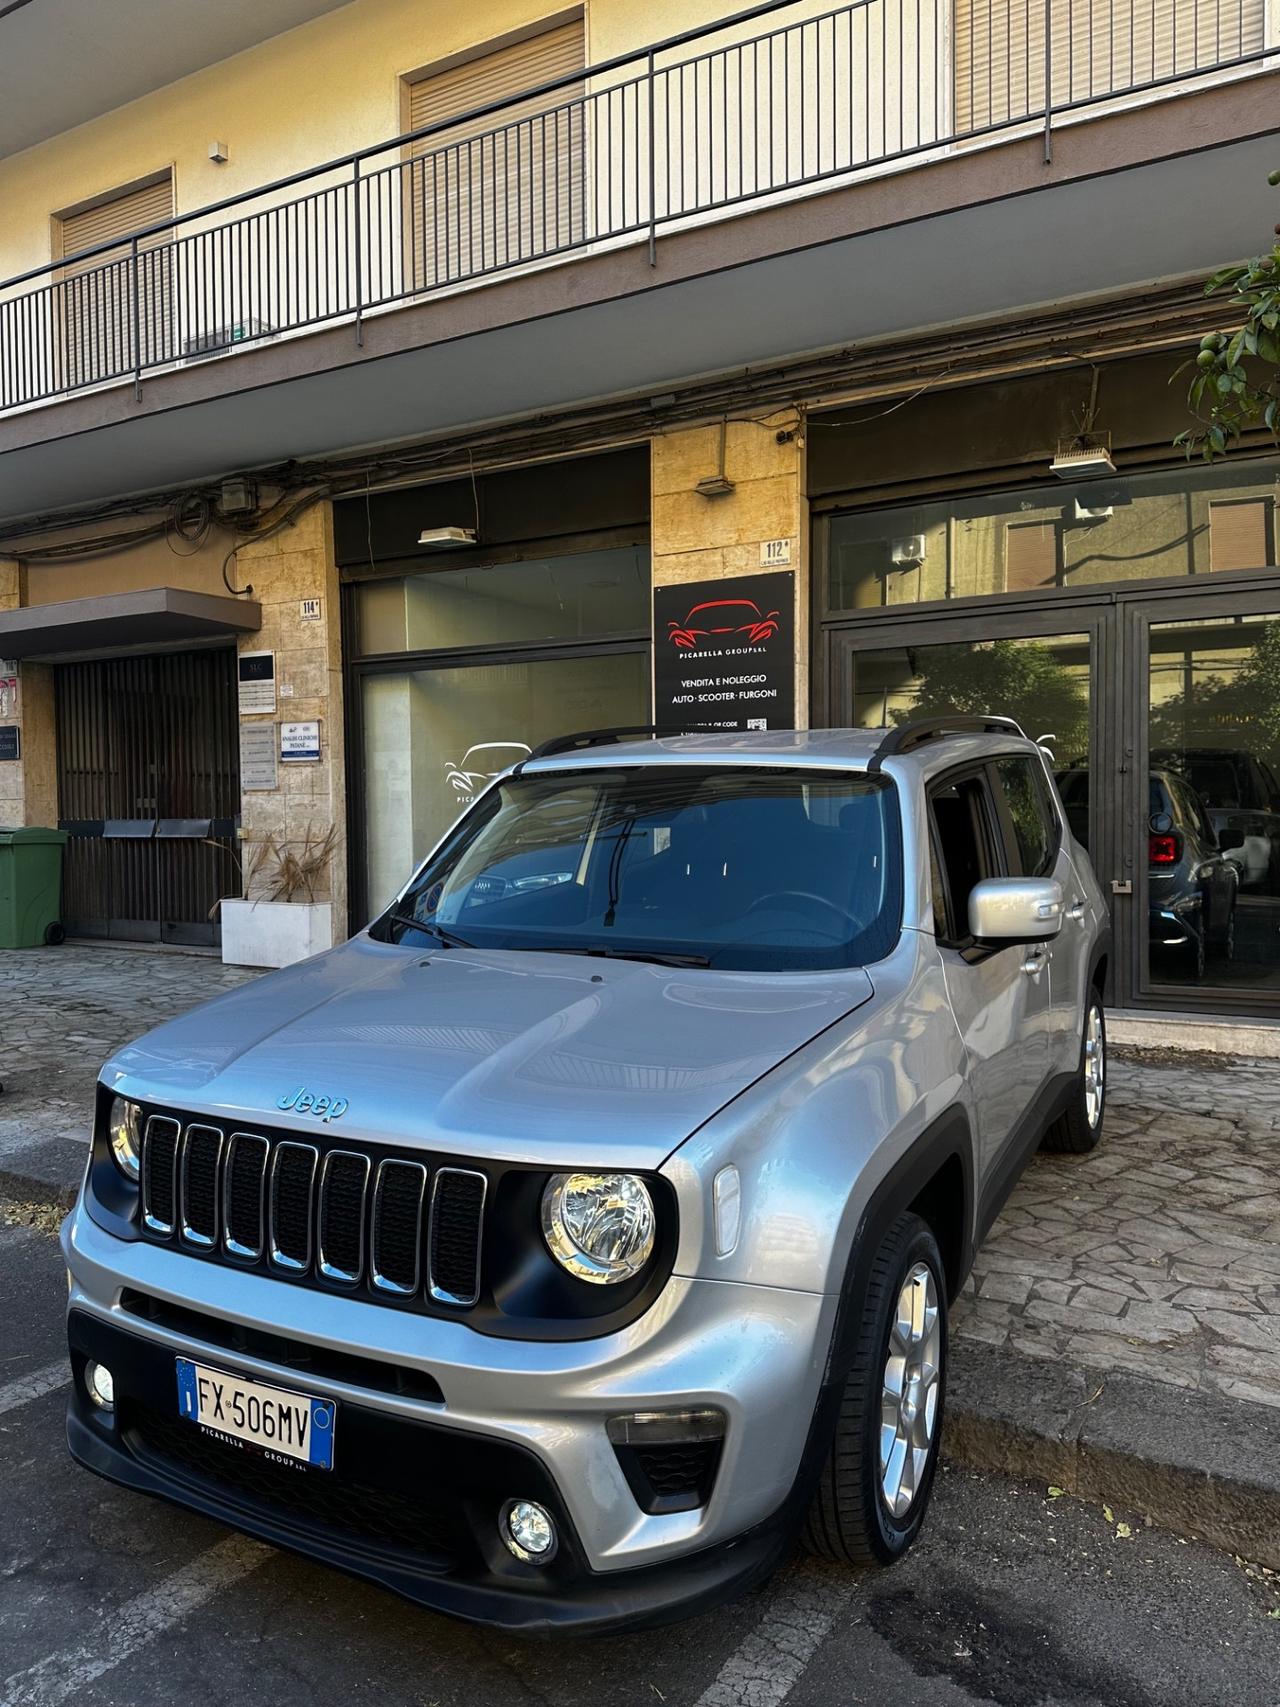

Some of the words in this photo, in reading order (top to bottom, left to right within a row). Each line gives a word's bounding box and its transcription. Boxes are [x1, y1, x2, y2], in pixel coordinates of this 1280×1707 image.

[679, 650, 722, 659] PICARELLA
[725, 647, 752, 656] GROUP
[681, 678, 714, 688] VENDITA
[716, 677, 721, 686] E
[722, 674, 767, 685] NOLEGGIO
[672, 694, 694, 704] AUTO
[698, 692, 735, 702] SCOOTER
[738, 689, 777, 699] FURGONI
[277, 1086, 349, 1123] Jeep
[201, 1426, 244, 1448] PICARELLA
[264, 1451, 294, 1466] GROUP
